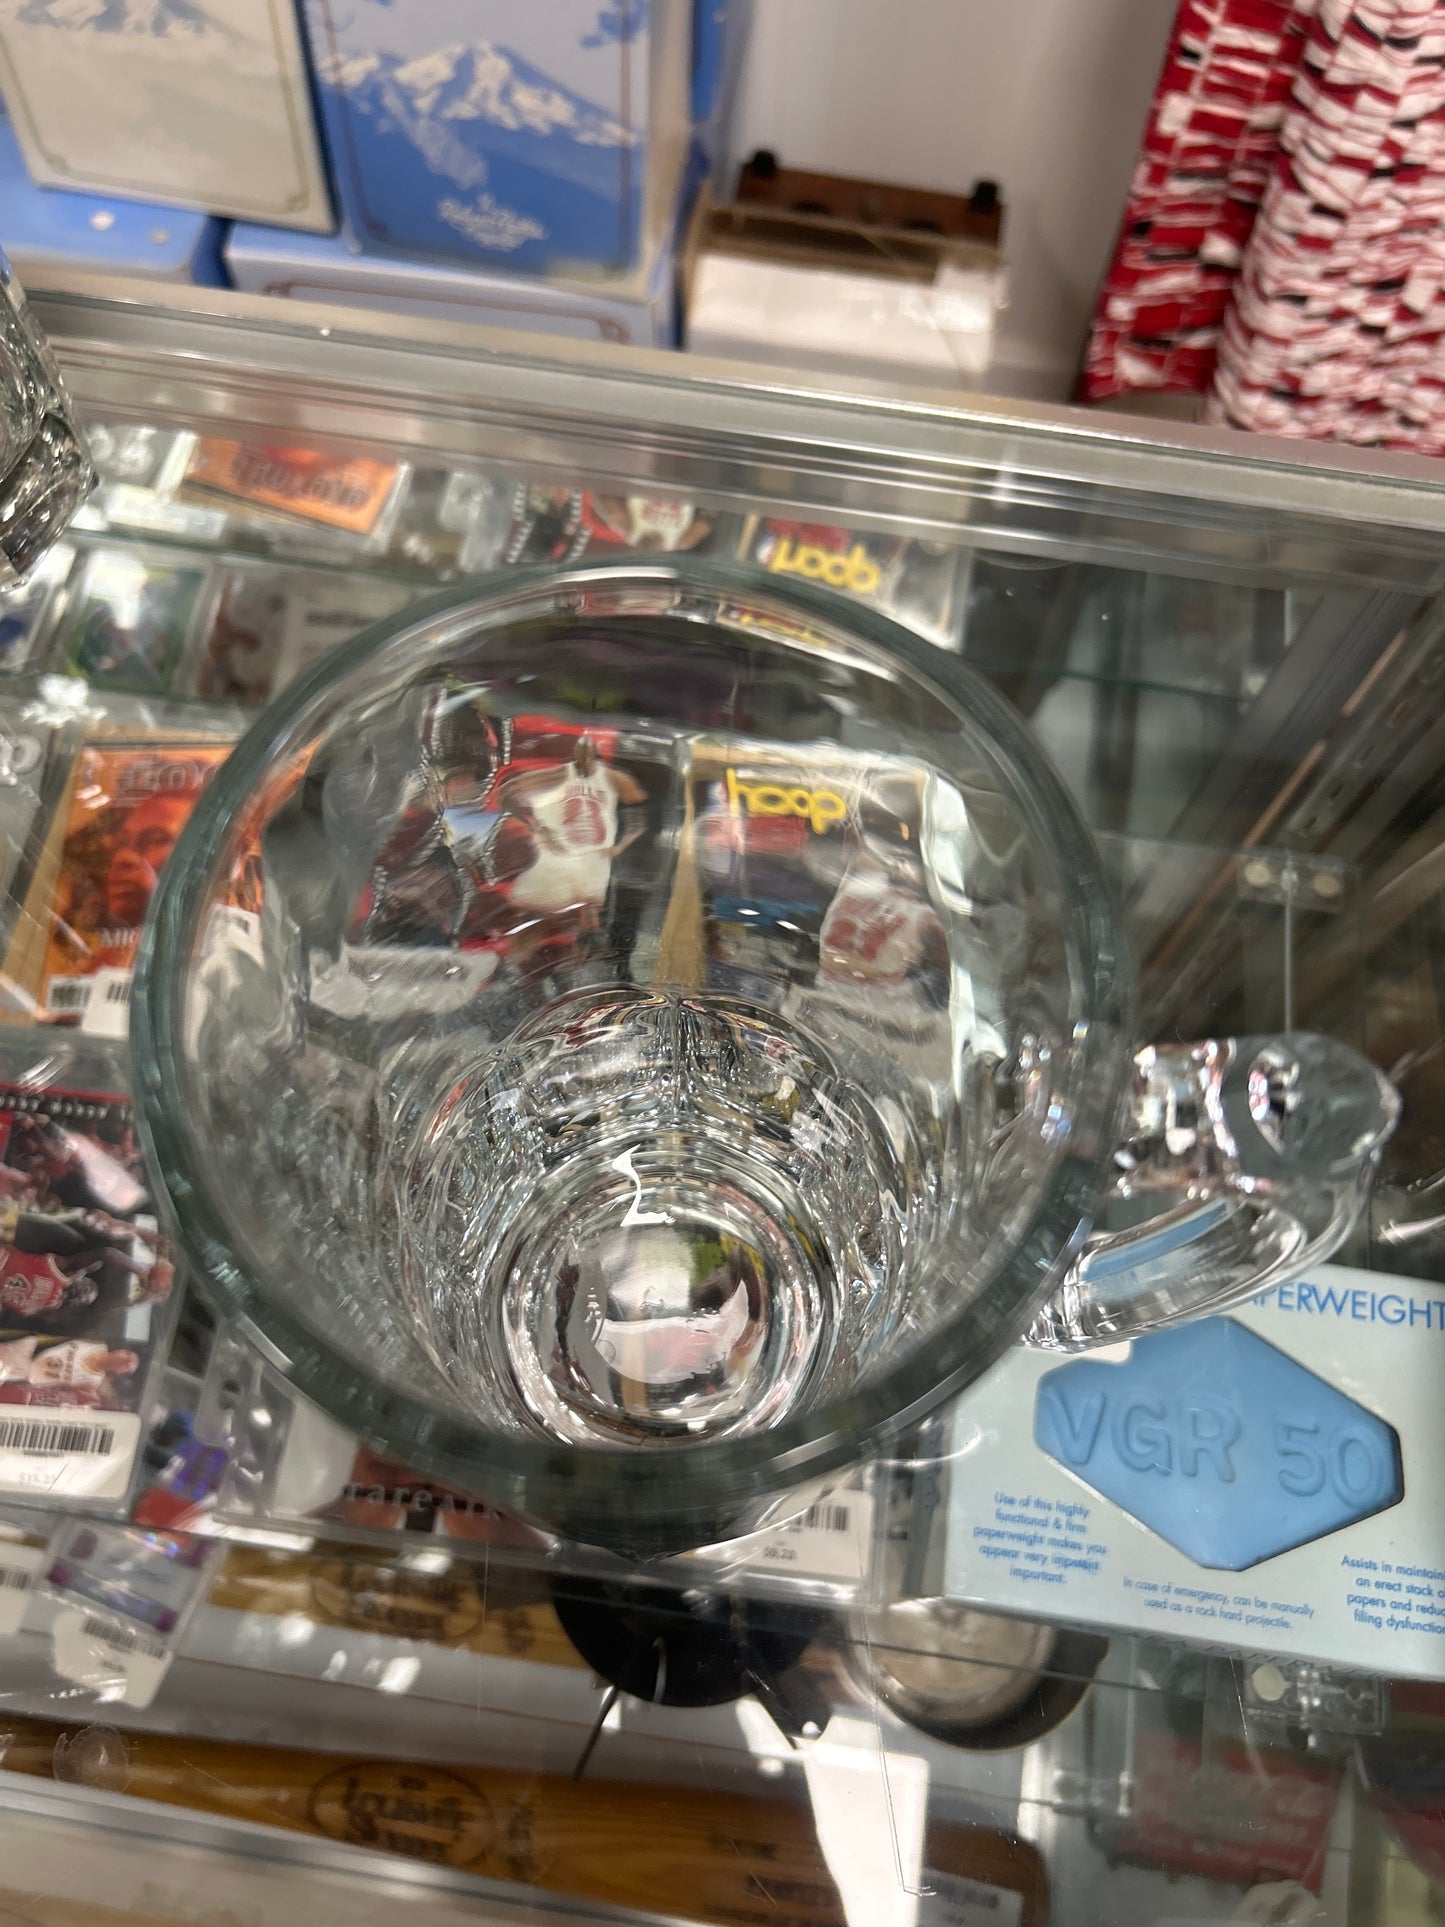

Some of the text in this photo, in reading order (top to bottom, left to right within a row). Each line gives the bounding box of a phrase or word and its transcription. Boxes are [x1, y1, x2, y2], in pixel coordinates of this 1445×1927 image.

[726, 768, 846, 834] hoop
[1252, 1281, 1445, 1331] PERWEIGHT
[1047, 1387, 1242, 1484] VGR
[1272, 1410, 1388, 1508] 50
[994, 1491, 1090, 1519] Use of this highly
[995, 1508, 1049, 1528] functional
[1053, 1517, 1062, 1530] &
[973, 1526, 1107, 1555] paperweight makes you
[979, 1545, 1020, 1560] appear
[1023, 1552, 1048, 1565] very
[1341, 1555, 1378, 1571] Assists
[1382, 1560, 1392, 1573] in
[1123, 1576, 1314, 1620] In case of emergency, can be manually
[1355, 1577, 1370, 1588] an
[1374, 1580, 1402, 1593] erect
[1405, 1584, 1434, 1597] stack
[1144, 1599, 1167, 1611] used
[1170, 1603, 1183, 1613] as
[1196, 1605, 1216, 1618] rock
[1219, 1608, 1242, 1622] hard
[1347, 1594, 1386, 1608] papers
[1390, 1599, 1412, 1612] and
[1354, 1607, 1383, 1628] filing
